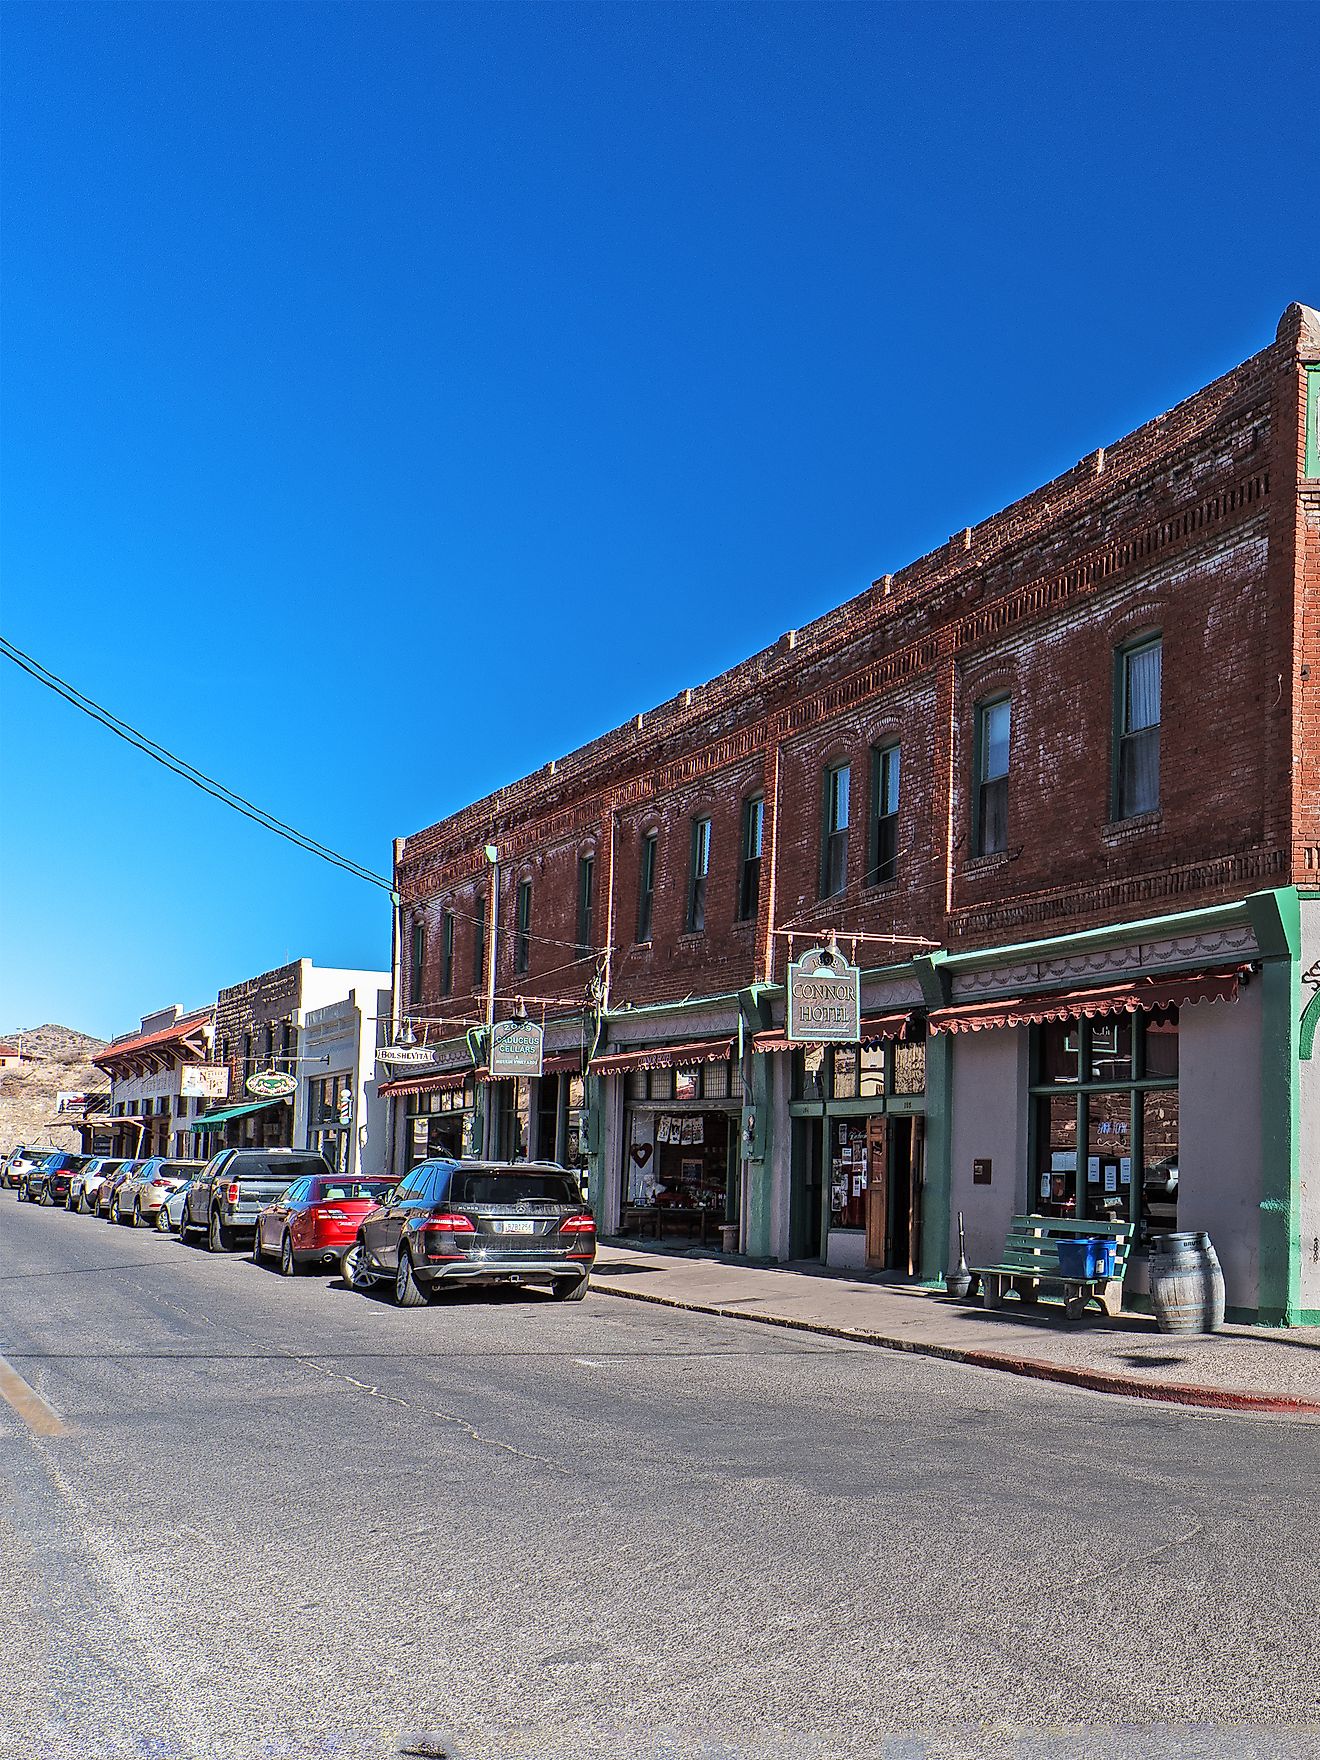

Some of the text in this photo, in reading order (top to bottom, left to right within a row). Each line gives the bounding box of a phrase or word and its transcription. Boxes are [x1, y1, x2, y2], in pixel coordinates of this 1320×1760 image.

[792, 983, 856, 1001] CONNOR
[800, 1006, 850, 1023] HOTEL
[496, 1036, 539, 1045] CADUCEUS
[499, 1045, 536, 1054] CELLARS
